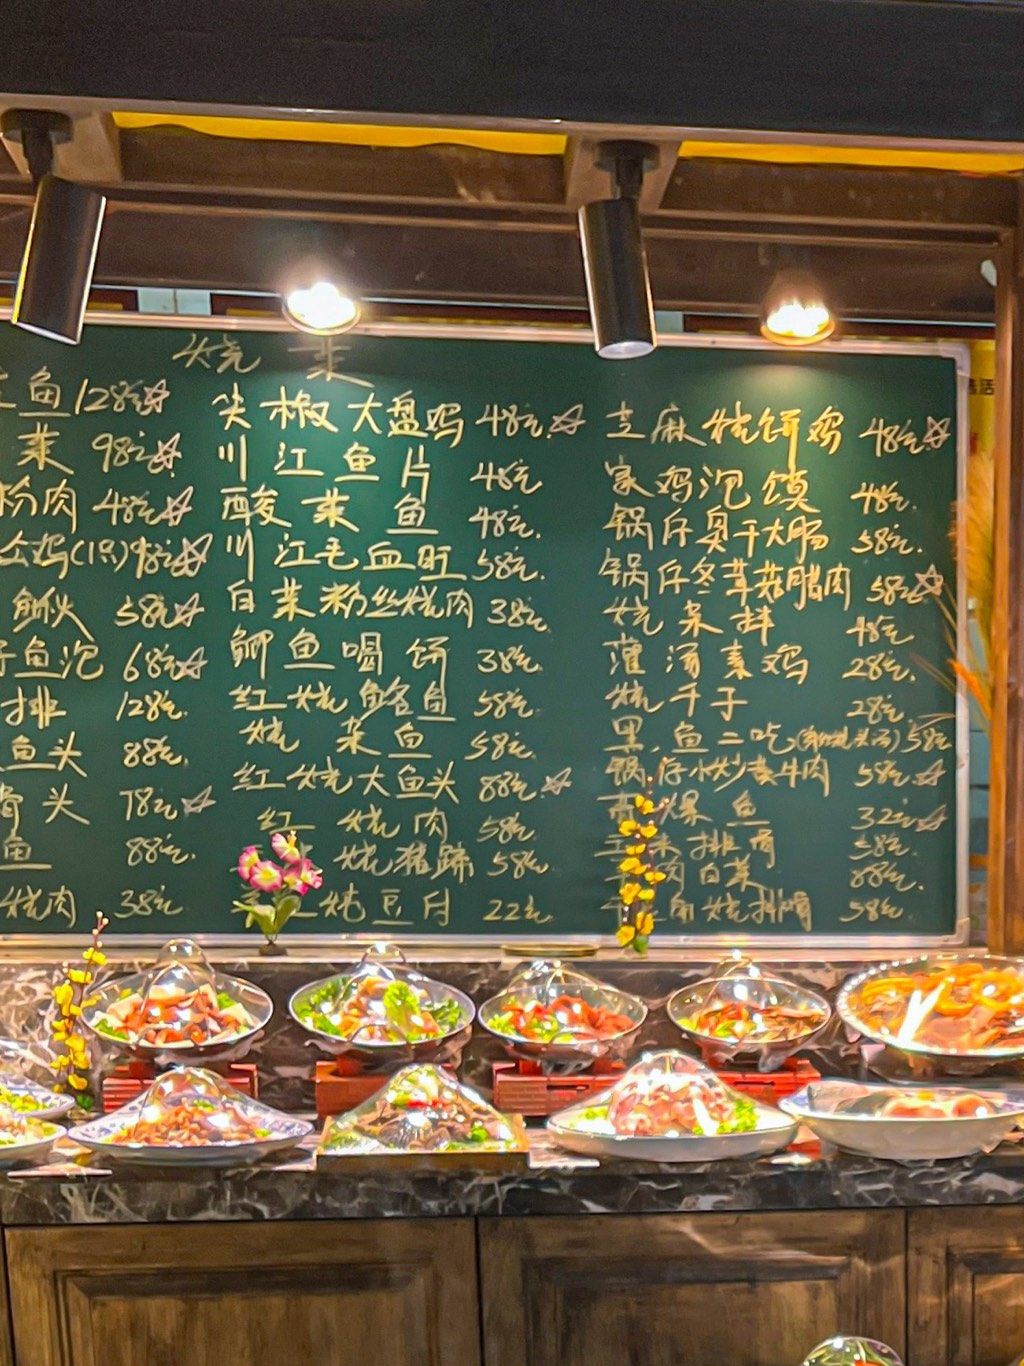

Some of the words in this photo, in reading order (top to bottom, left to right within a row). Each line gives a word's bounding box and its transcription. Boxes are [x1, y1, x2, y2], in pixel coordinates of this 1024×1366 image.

[212, 382, 465, 448] 尖椒大盘鸡
[218, 434, 432, 504] 川江鱼片
[220, 484, 440, 536] 酸菜鱼
[225, 528, 468, 582] 川江毛血旺
[239, 716, 433, 759] 烧杂鱼
[232, 756, 461, 804] 红烧大鱼头
[257, 803, 449, 844] 红烧肉
